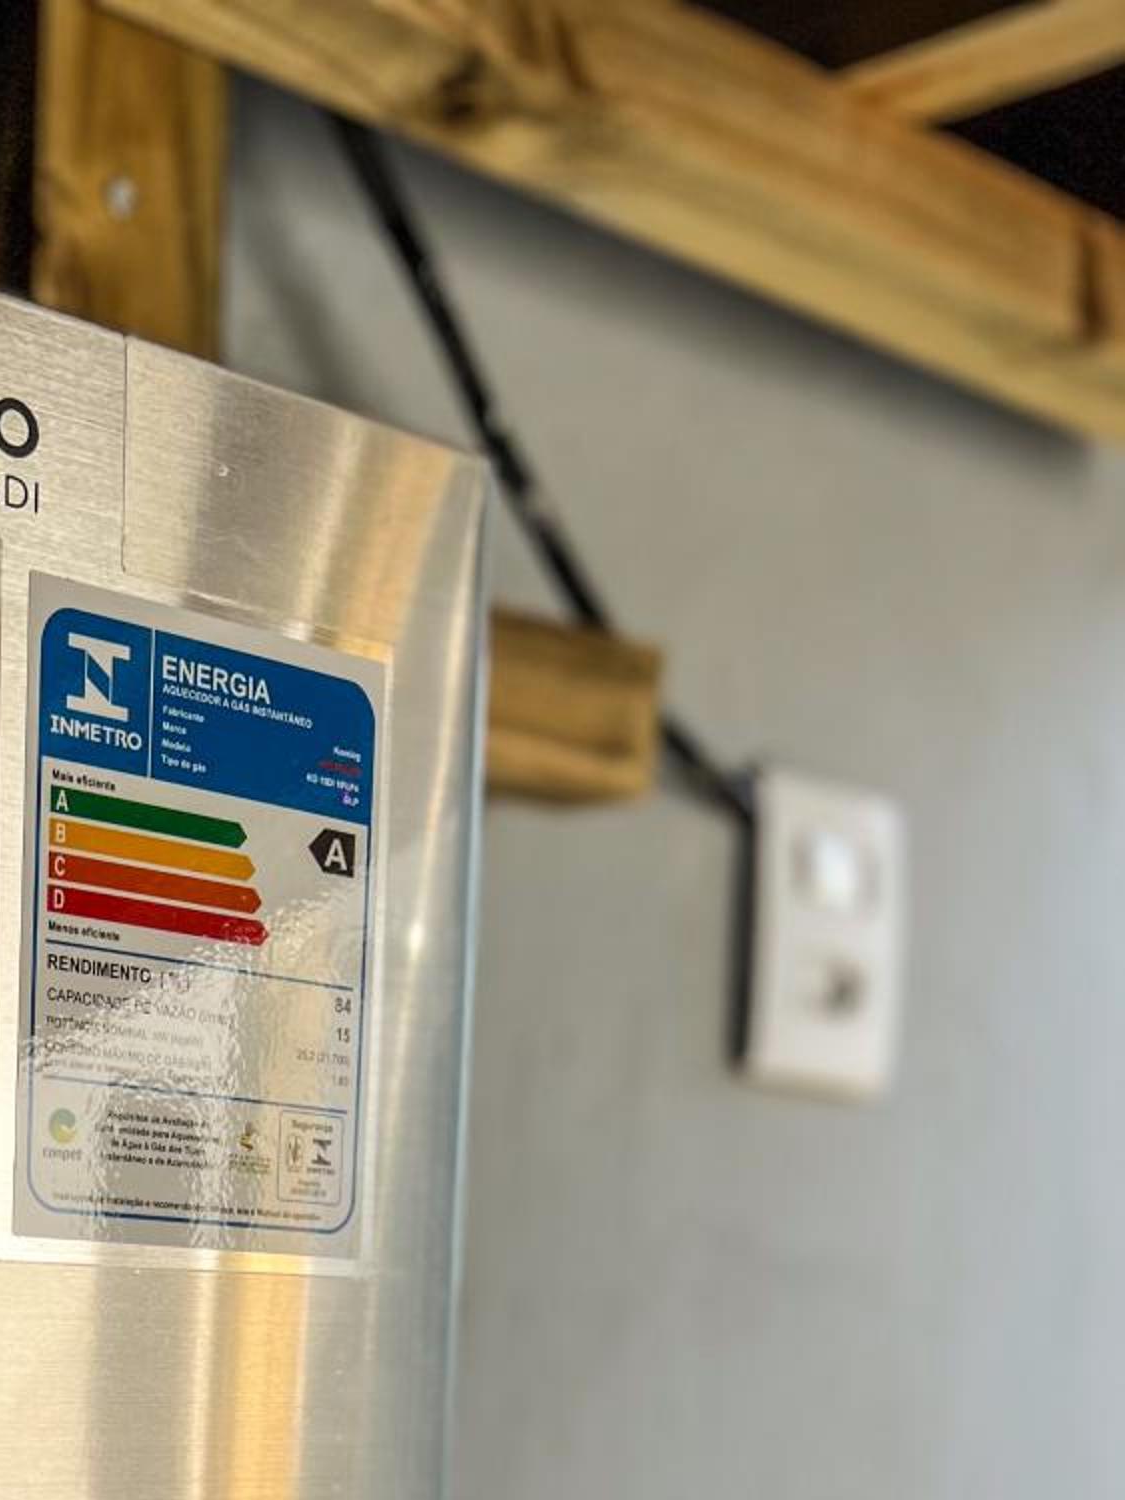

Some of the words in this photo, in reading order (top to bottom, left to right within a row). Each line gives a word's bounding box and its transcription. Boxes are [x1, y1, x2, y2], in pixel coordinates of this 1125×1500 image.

[162, 655, 271, 704] ENERGIA
[162, 683, 221, 707] AQUECEDOR
[219, 698, 230, 709] A
[230, 700, 251, 713] GÁS
[252, 705, 314, 729] INSTANTÂNEO
[162, 705, 206, 723] Fabricante
[50, 714, 142, 751] INMETRO
[162, 721, 187, 735] Marca
[161, 753, 179, 768] Tipo
[52, 769, 74, 782] Mais
[76, 774, 116, 791] eficiente
[56, 789, 69, 812] A
[56, 822, 66, 844] B
[324, 838, 348, 871] A
[54, 855, 66, 878] C
[53, 888, 65, 909] D
[48, 919, 79, 935] Menos
[81, 924, 121, 942] eficiente
[47, 953, 152, 983] RENDIMENTO
[335, 997, 351, 1014] 84
[337, 1027, 351, 1043] 15
